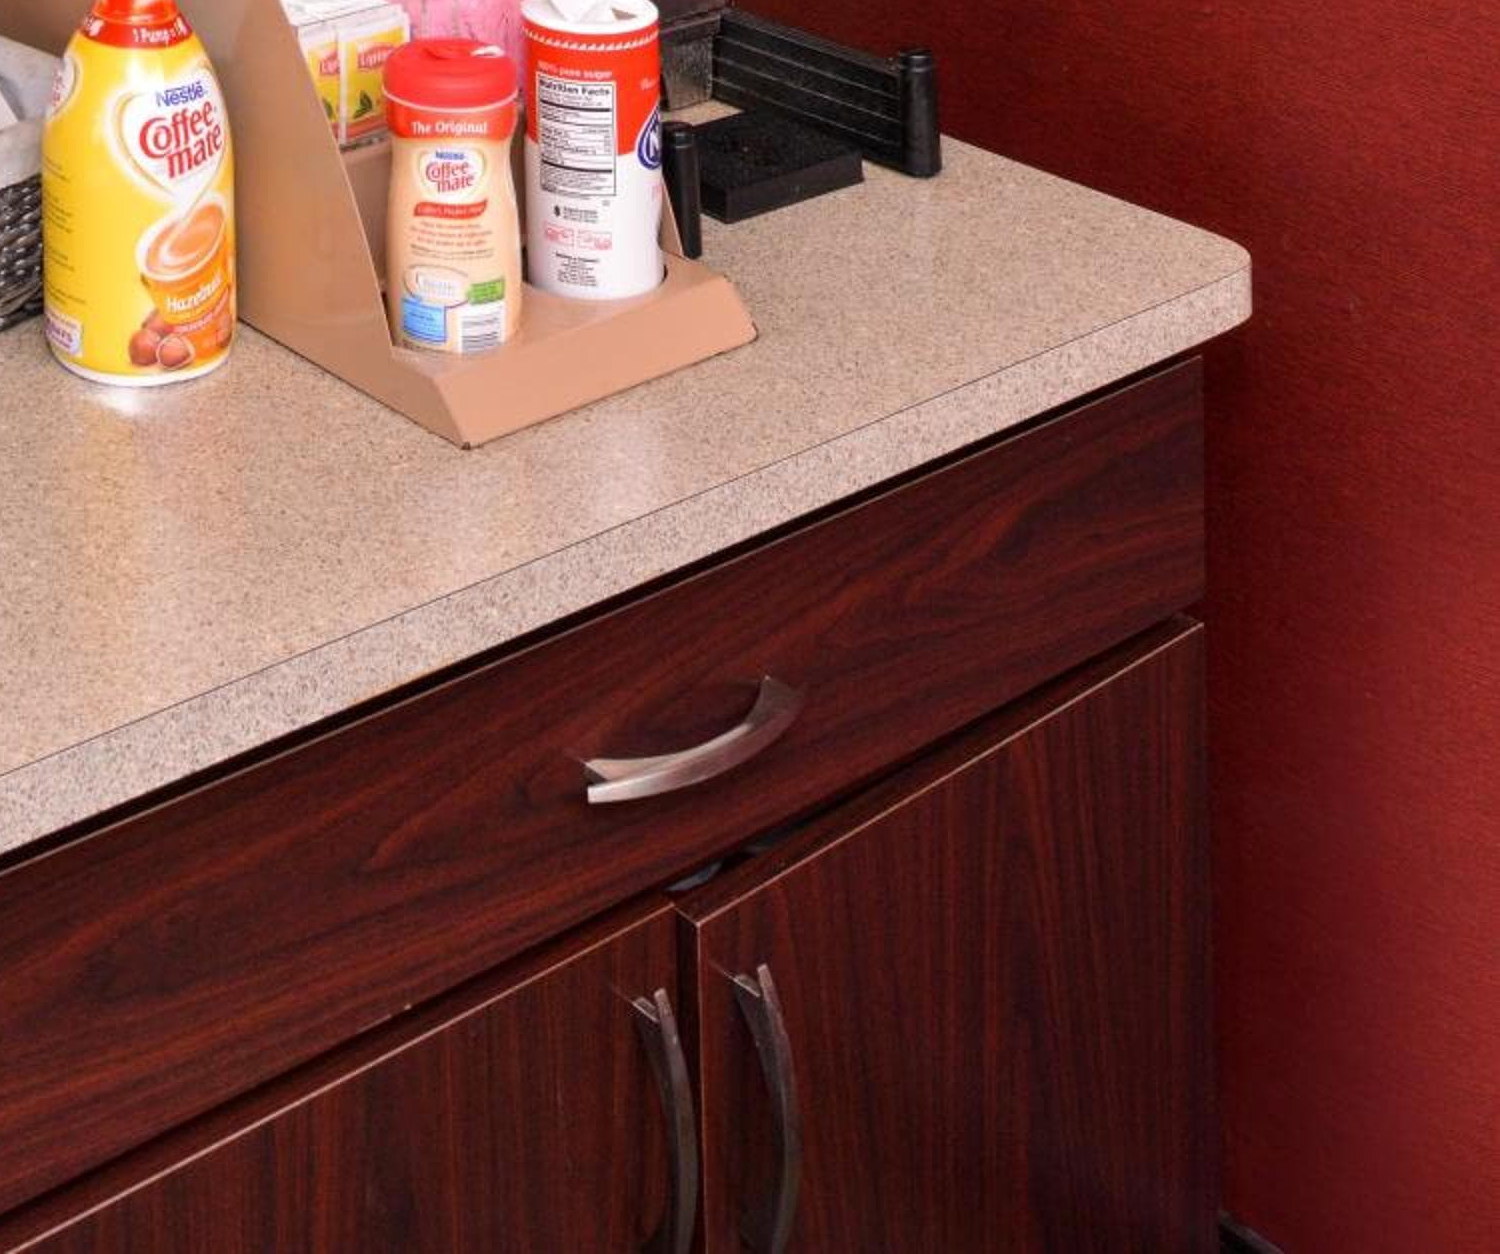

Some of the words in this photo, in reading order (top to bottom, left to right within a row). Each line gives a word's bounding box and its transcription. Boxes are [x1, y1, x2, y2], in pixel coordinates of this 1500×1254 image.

[139, 101, 214, 159] Coffee
[411, 121, 432, 135] The
[435, 121, 488, 136] Original
[167, 124, 223, 179] mate
[425, 162, 470, 183] Coffee
